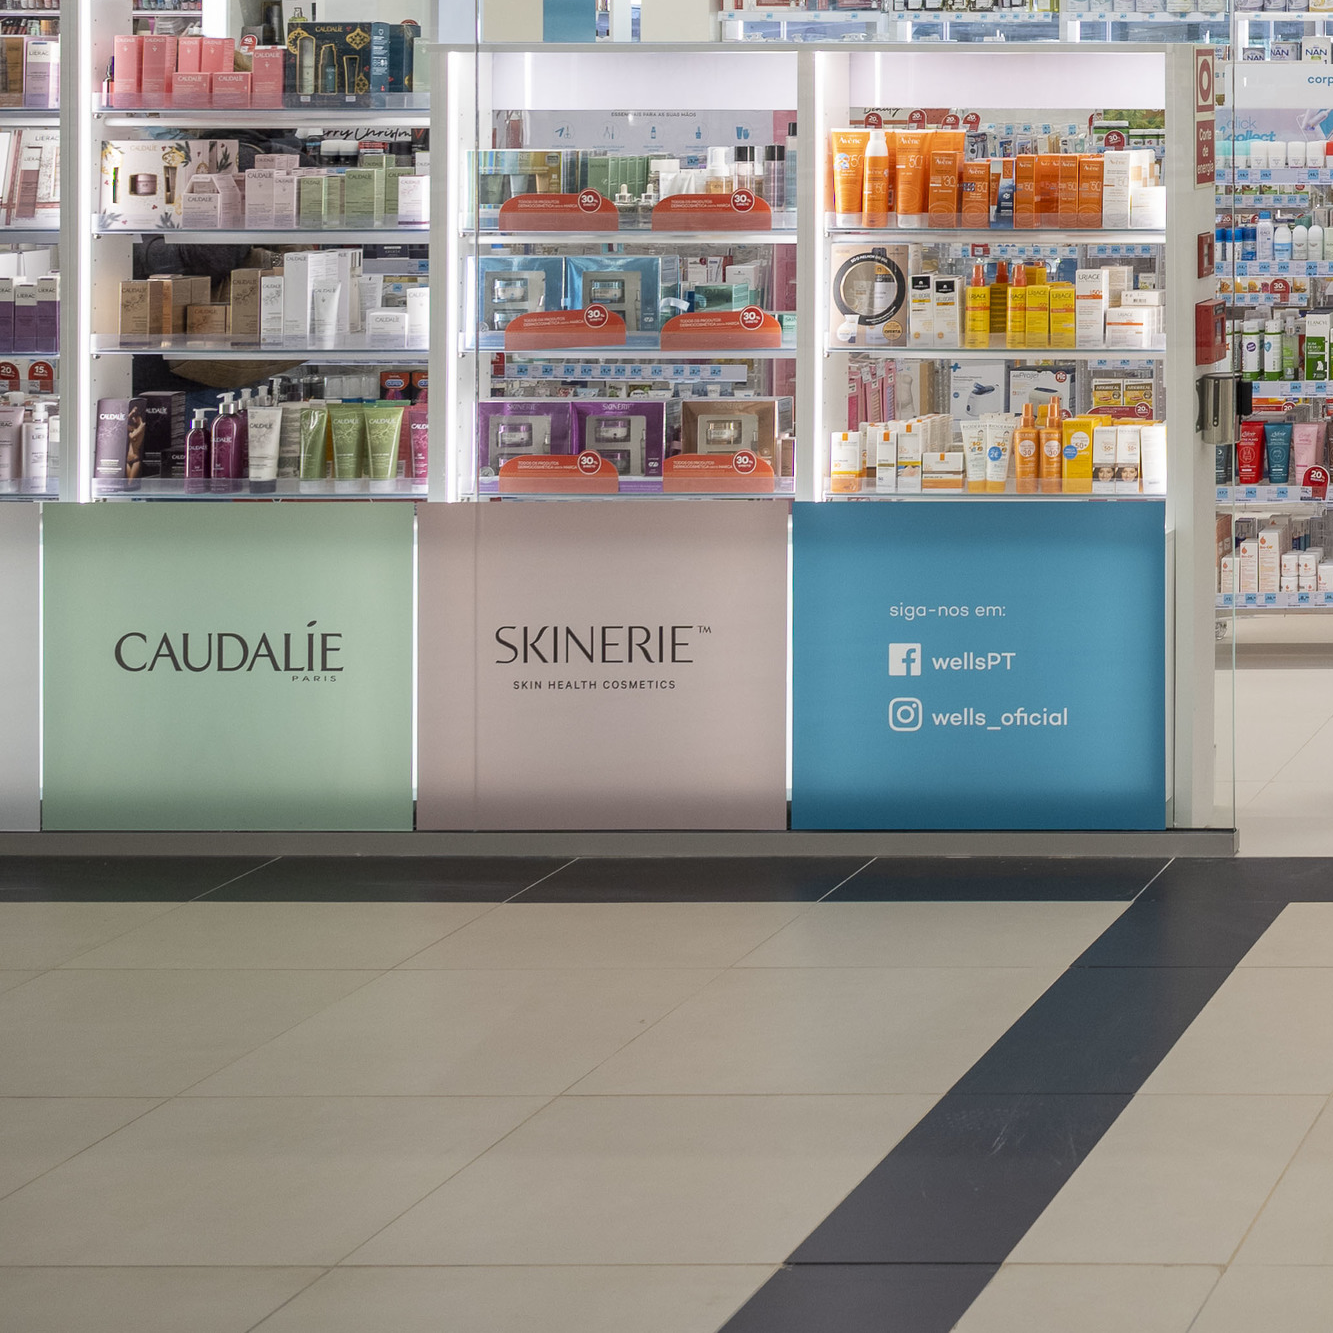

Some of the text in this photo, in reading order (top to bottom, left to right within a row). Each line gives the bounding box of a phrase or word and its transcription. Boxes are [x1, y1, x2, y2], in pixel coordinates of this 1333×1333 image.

[1305, 48, 1328, 56] NAN
[1199, 128, 1212, 141] Corte
[1202, 145, 1209, 157] de
[580, 194, 599, 205] 30%
[734, 194, 752, 205] 30%
[587, 310, 606, 320] 30%
[743, 310, 762, 321] 30%
[580, 455, 599, 466] 30%
[736, 455, 754, 466] 30%
[889, 602, 1007, 621] siga-nos em:
[114, 620, 344, 672] CAUDALÍE
[931, 651, 1016, 671] wellsPT
[513, 680, 676, 690] SKIN HEALTH COSMETICS
[931, 707, 1068, 730] wells_oficial
